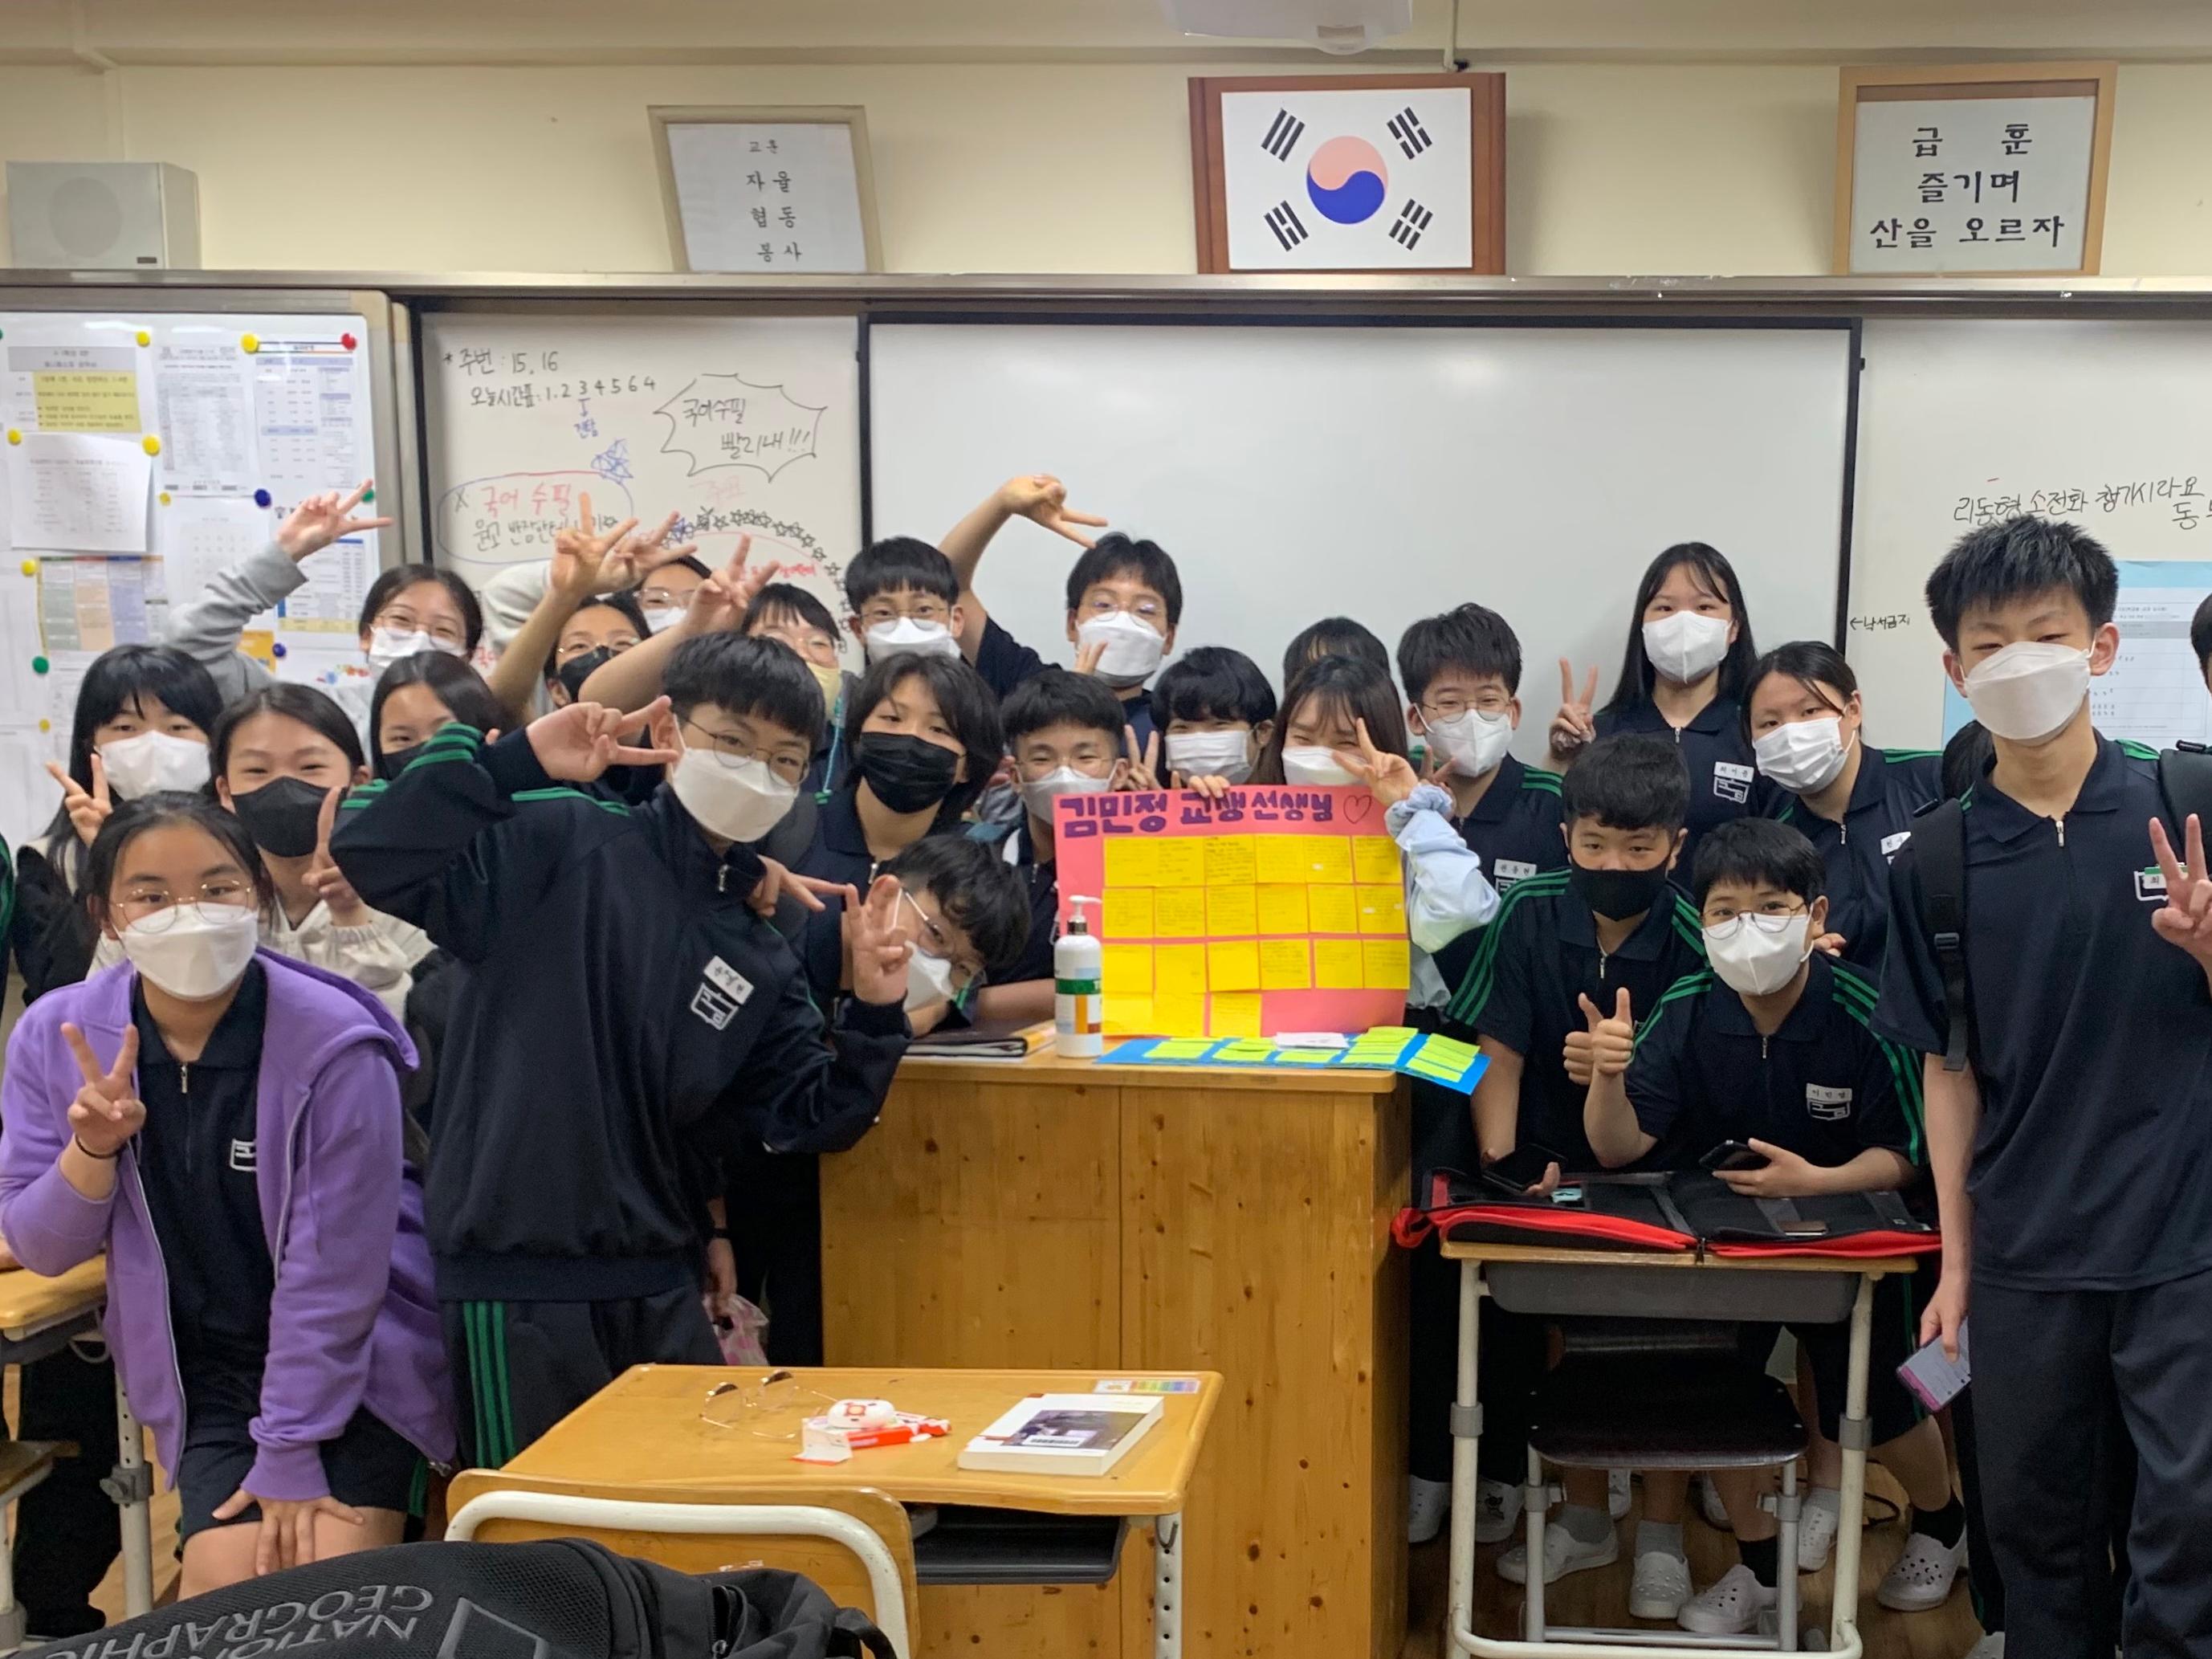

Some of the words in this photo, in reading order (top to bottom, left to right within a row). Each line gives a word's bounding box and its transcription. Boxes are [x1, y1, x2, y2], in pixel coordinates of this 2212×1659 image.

[746, 170, 792, 194] 자율
[1917, 169, 2019, 203] 즐기며
[750, 206, 796, 229] 협동
[1870, 218, 1937, 249] 산을
[1959, 214, 2065, 248] 오르자
[756, 241, 802, 263] 봉사
[458, 347, 495, 377] 주번
[541, 350, 560, 373] 16
[579, 380, 589, 395] 3
[594, 379, 605, 396] 4
[611, 378, 621, 394] 5
[628, 375, 638, 392] 6
[643, 375, 656, 392] 4
[682, 397, 747, 428] 국어수필
[2171, 500, 2212, 531] 동
[1864, 613, 1910, 632] 낙서금지
[1058, 793, 1169, 838] 김민정
[1179, 790, 1246, 825] 교생
[1251, 790, 1334, 823] 선생님
